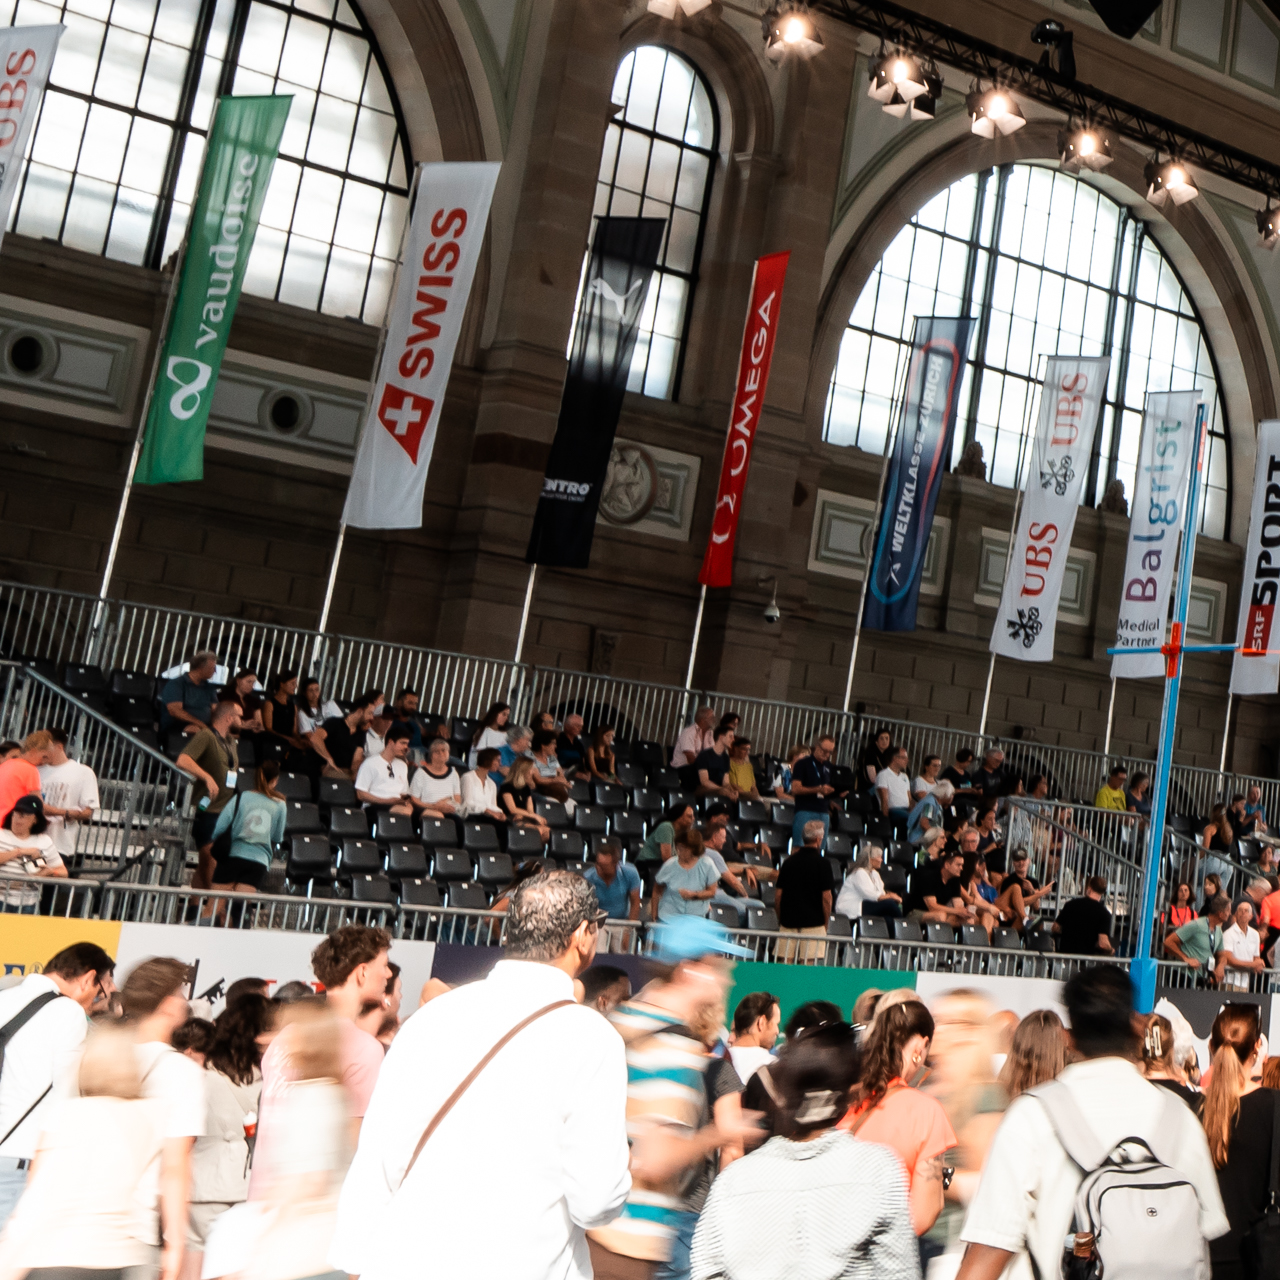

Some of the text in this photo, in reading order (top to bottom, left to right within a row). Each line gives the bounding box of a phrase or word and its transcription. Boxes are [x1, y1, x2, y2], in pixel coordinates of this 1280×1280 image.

[195, 153, 259, 350] vaudoise
[398, 207, 468, 379] SWISS
[1050, 372, 1088, 448] UBS
[891, 355, 943, 553] WELTKLASSE ZÜRICH
[1125, 420, 1182, 602] Balgrist
[1020, 521, 1059, 598] UBS
[1116, 633, 1158, 648] Partner
[1117, 617, 1160, 632] Medical
[1252, 610, 1264, 652] SRF
